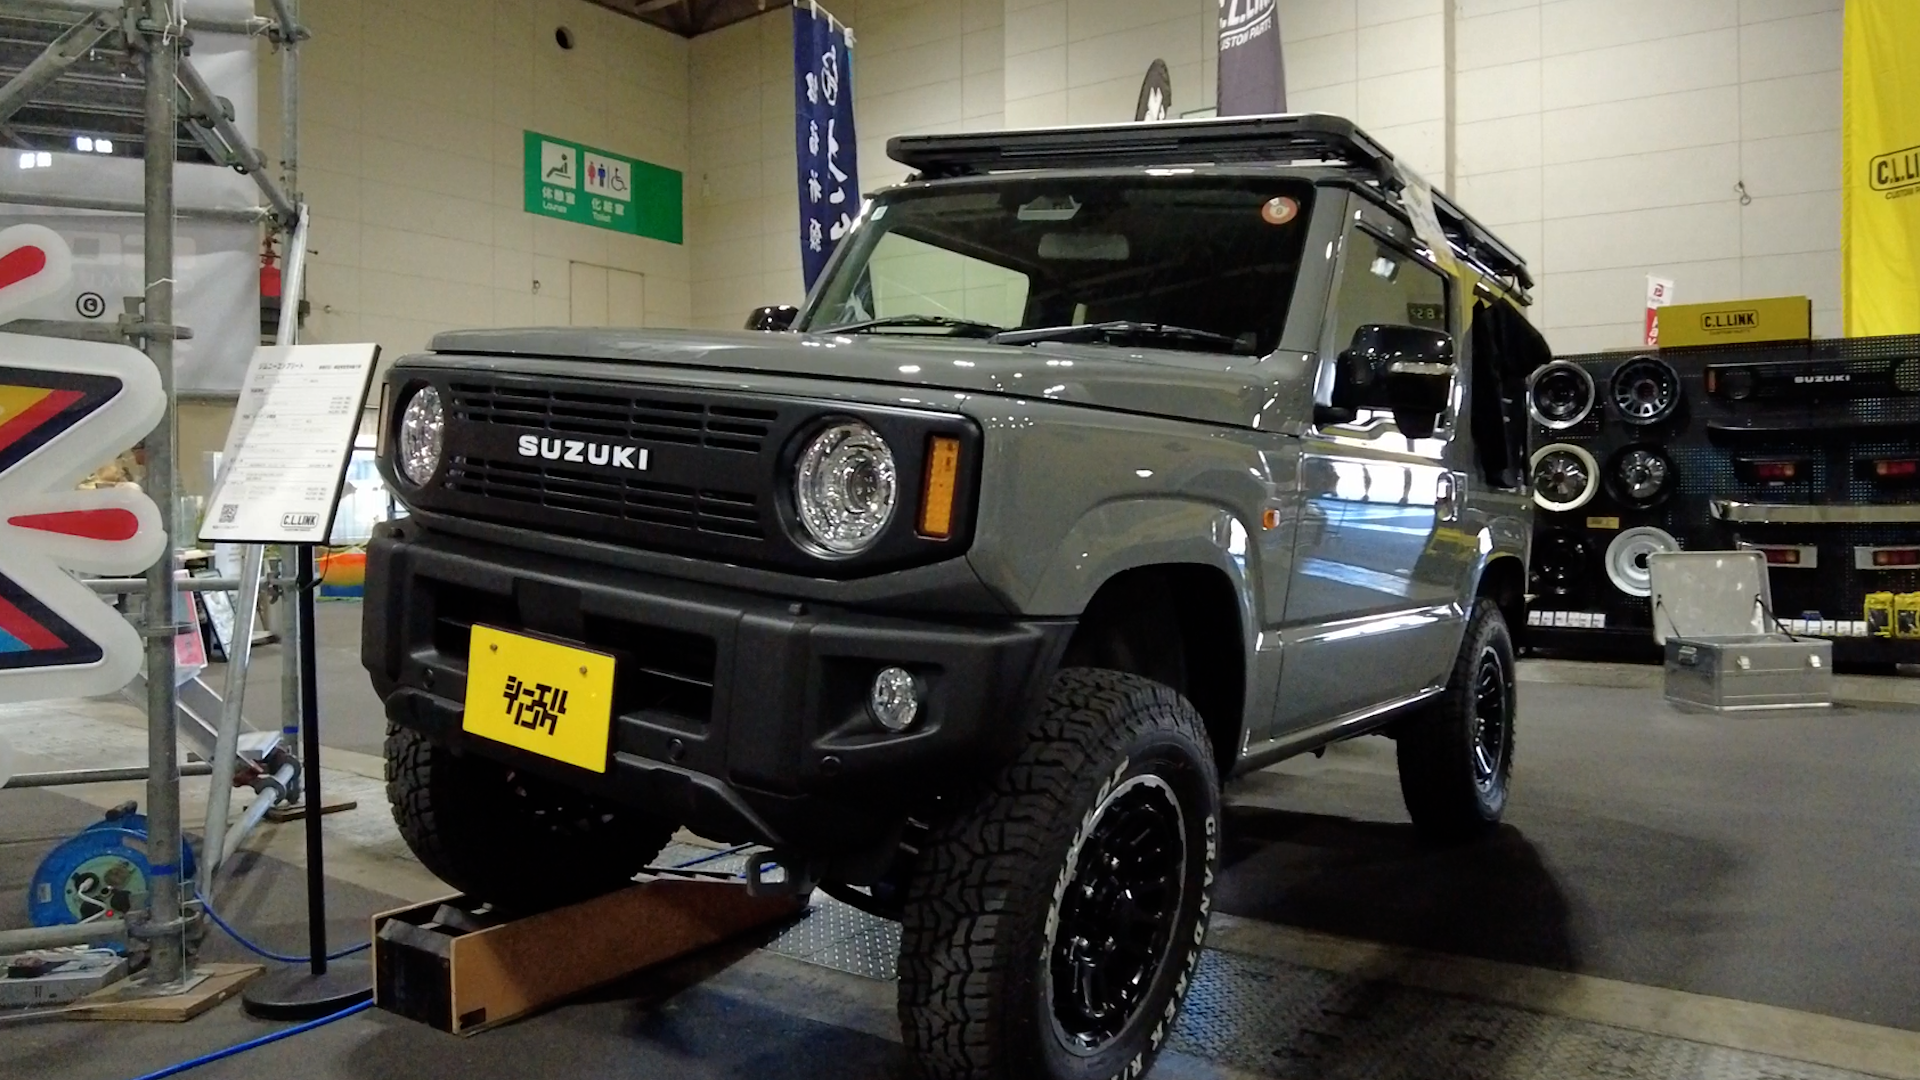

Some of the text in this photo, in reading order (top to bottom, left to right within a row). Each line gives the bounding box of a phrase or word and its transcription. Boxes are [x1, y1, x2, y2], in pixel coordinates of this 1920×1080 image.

[1704, 313, 1755, 328] C.L.LINK
[1794, 374, 1851, 384] SUZUKI
[518, 434, 649, 471] SUZUKI
[1150, 814, 1216, 1052] GRANDTREK
